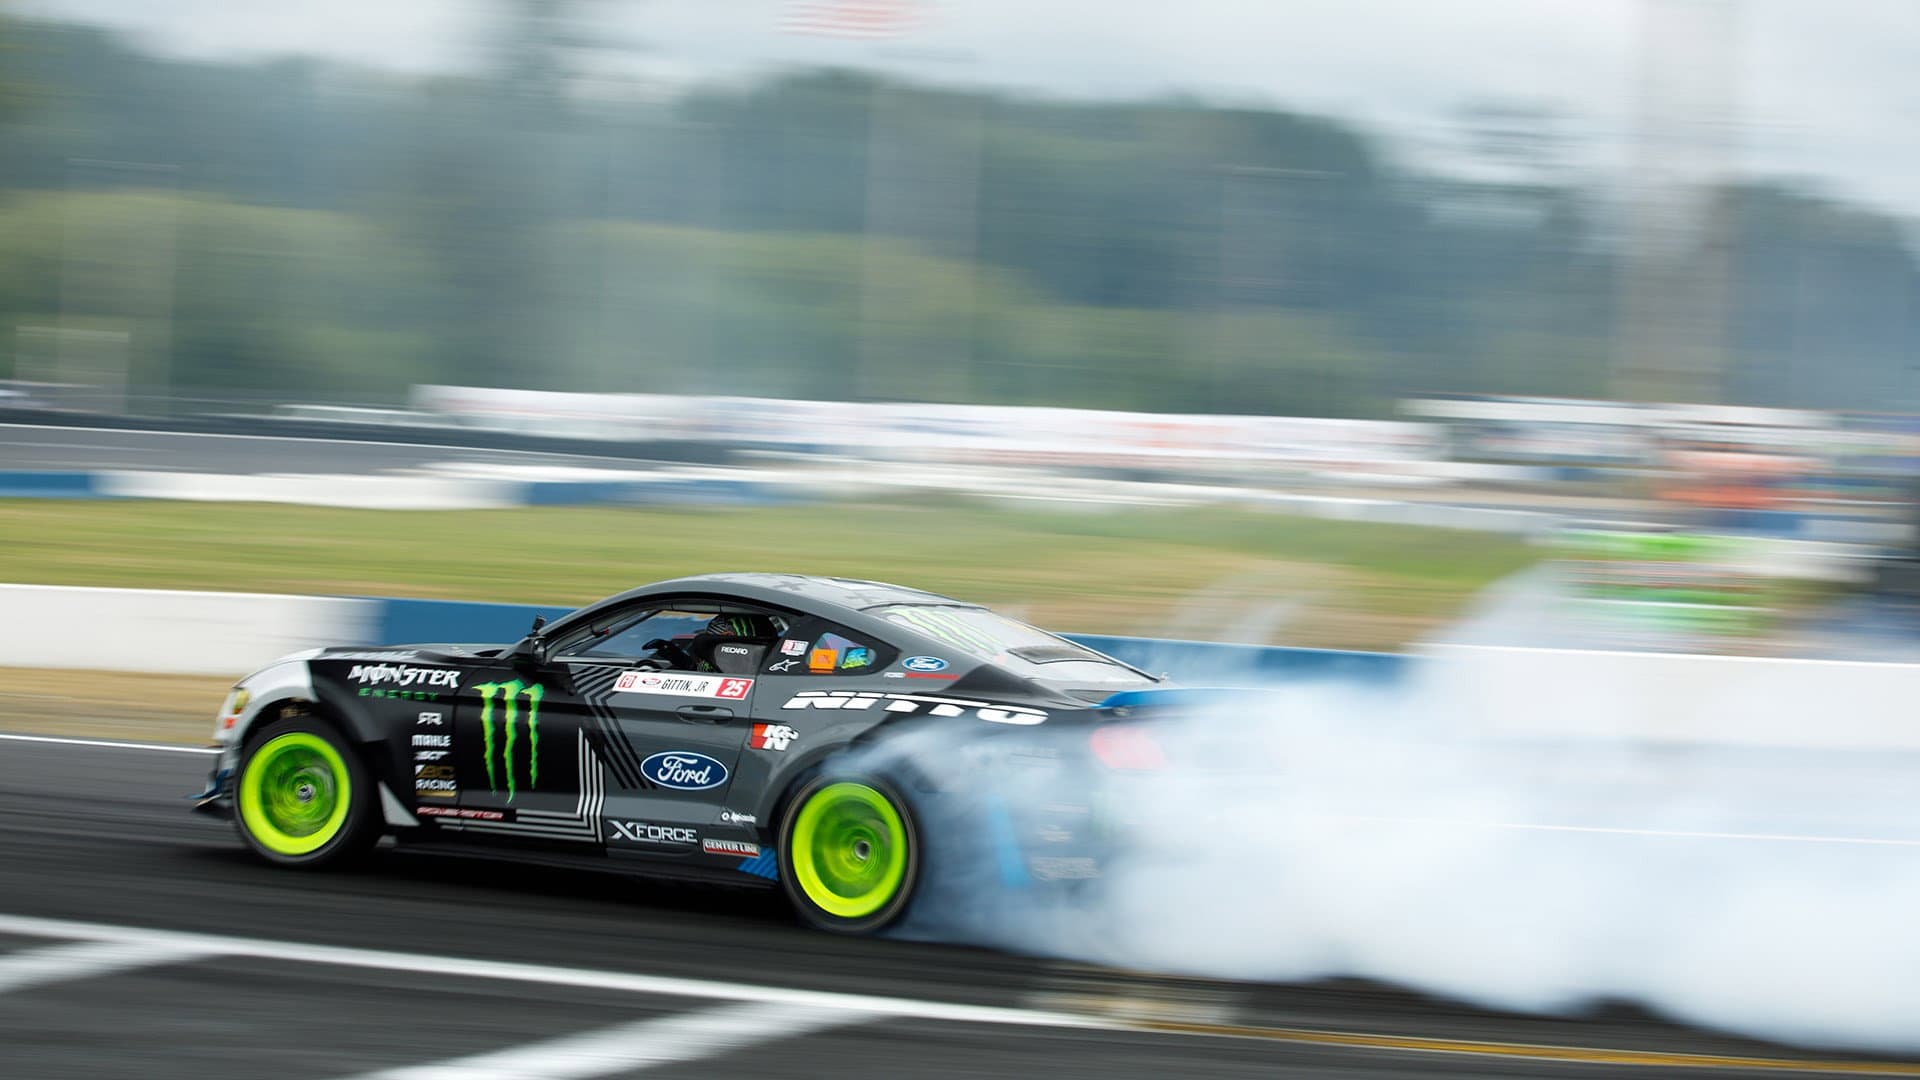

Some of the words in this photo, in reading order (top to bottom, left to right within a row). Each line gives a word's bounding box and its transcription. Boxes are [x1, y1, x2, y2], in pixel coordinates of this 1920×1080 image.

[347, 663, 461, 688] MONSTER
[720, 679, 747, 698] 25
[781, 691, 1048, 725] NITTO
[655, 754, 713, 786] Ford
[608, 820, 698, 843] XFORCE
